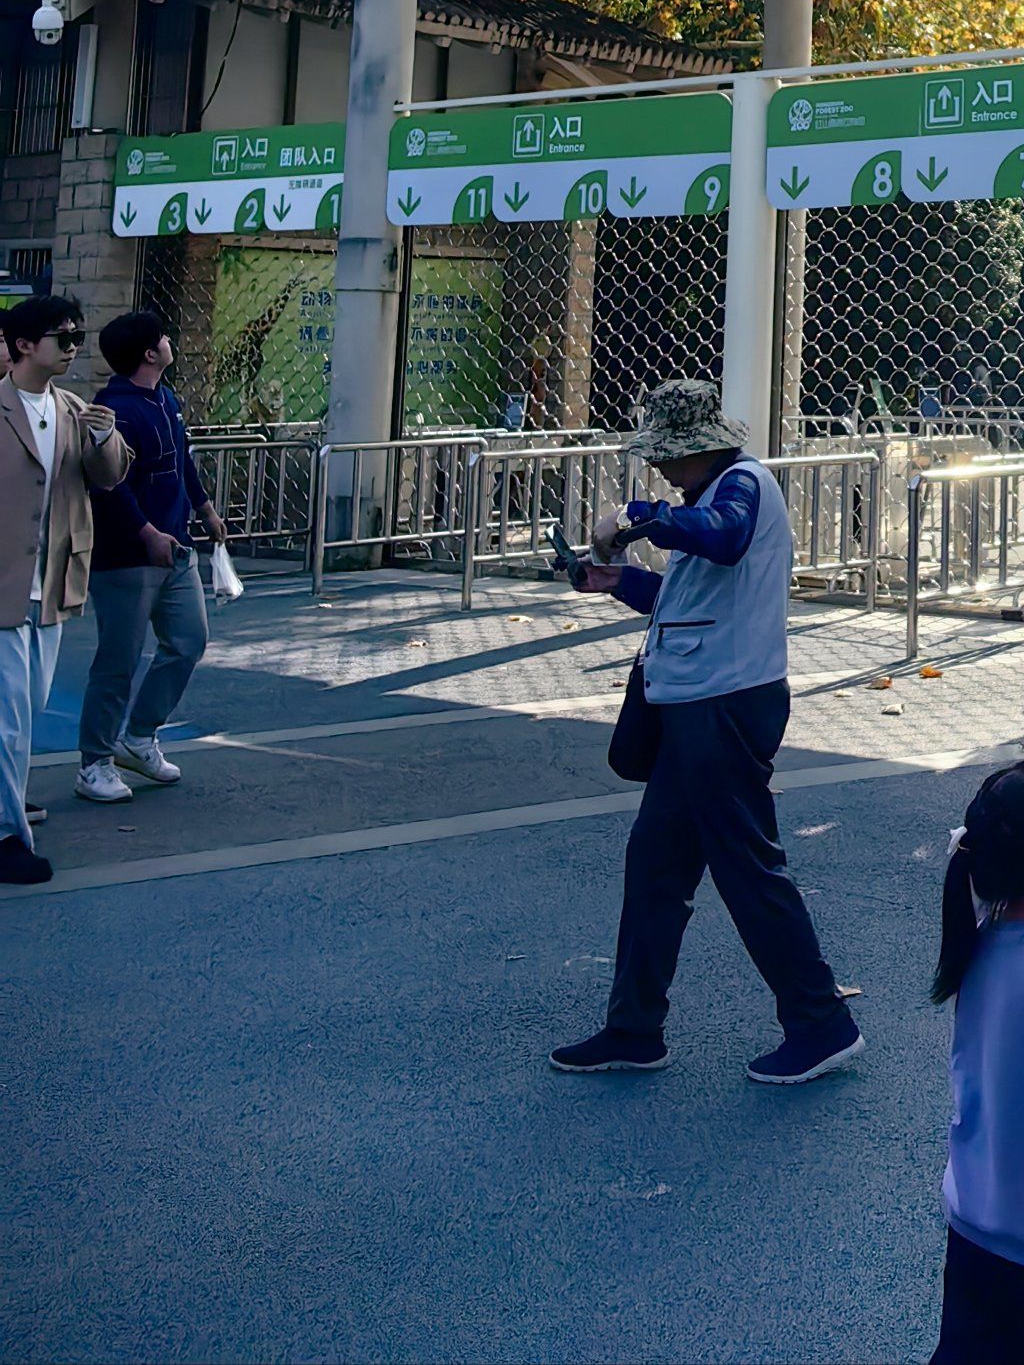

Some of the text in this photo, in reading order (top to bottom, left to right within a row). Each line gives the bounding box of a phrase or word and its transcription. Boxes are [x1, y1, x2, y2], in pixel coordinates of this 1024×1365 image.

[971, 80, 1012, 106] 入口
[549, 116, 582, 138] 入口
[971, 111, 1017, 122] Entrance
[241, 137, 269, 158] 入口
[280, 146, 335, 166] 团队入口
[549, 143, 585, 153] Entrance
[704, 176, 721, 211] 9
[872, 161, 893, 198] 8
[243, 198, 259, 228] 2
[330, 194, 340, 224] 1
[467, 188, 487, 218] 11
[578, 182, 602, 214] 10
[168, 202, 181, 232] 3
